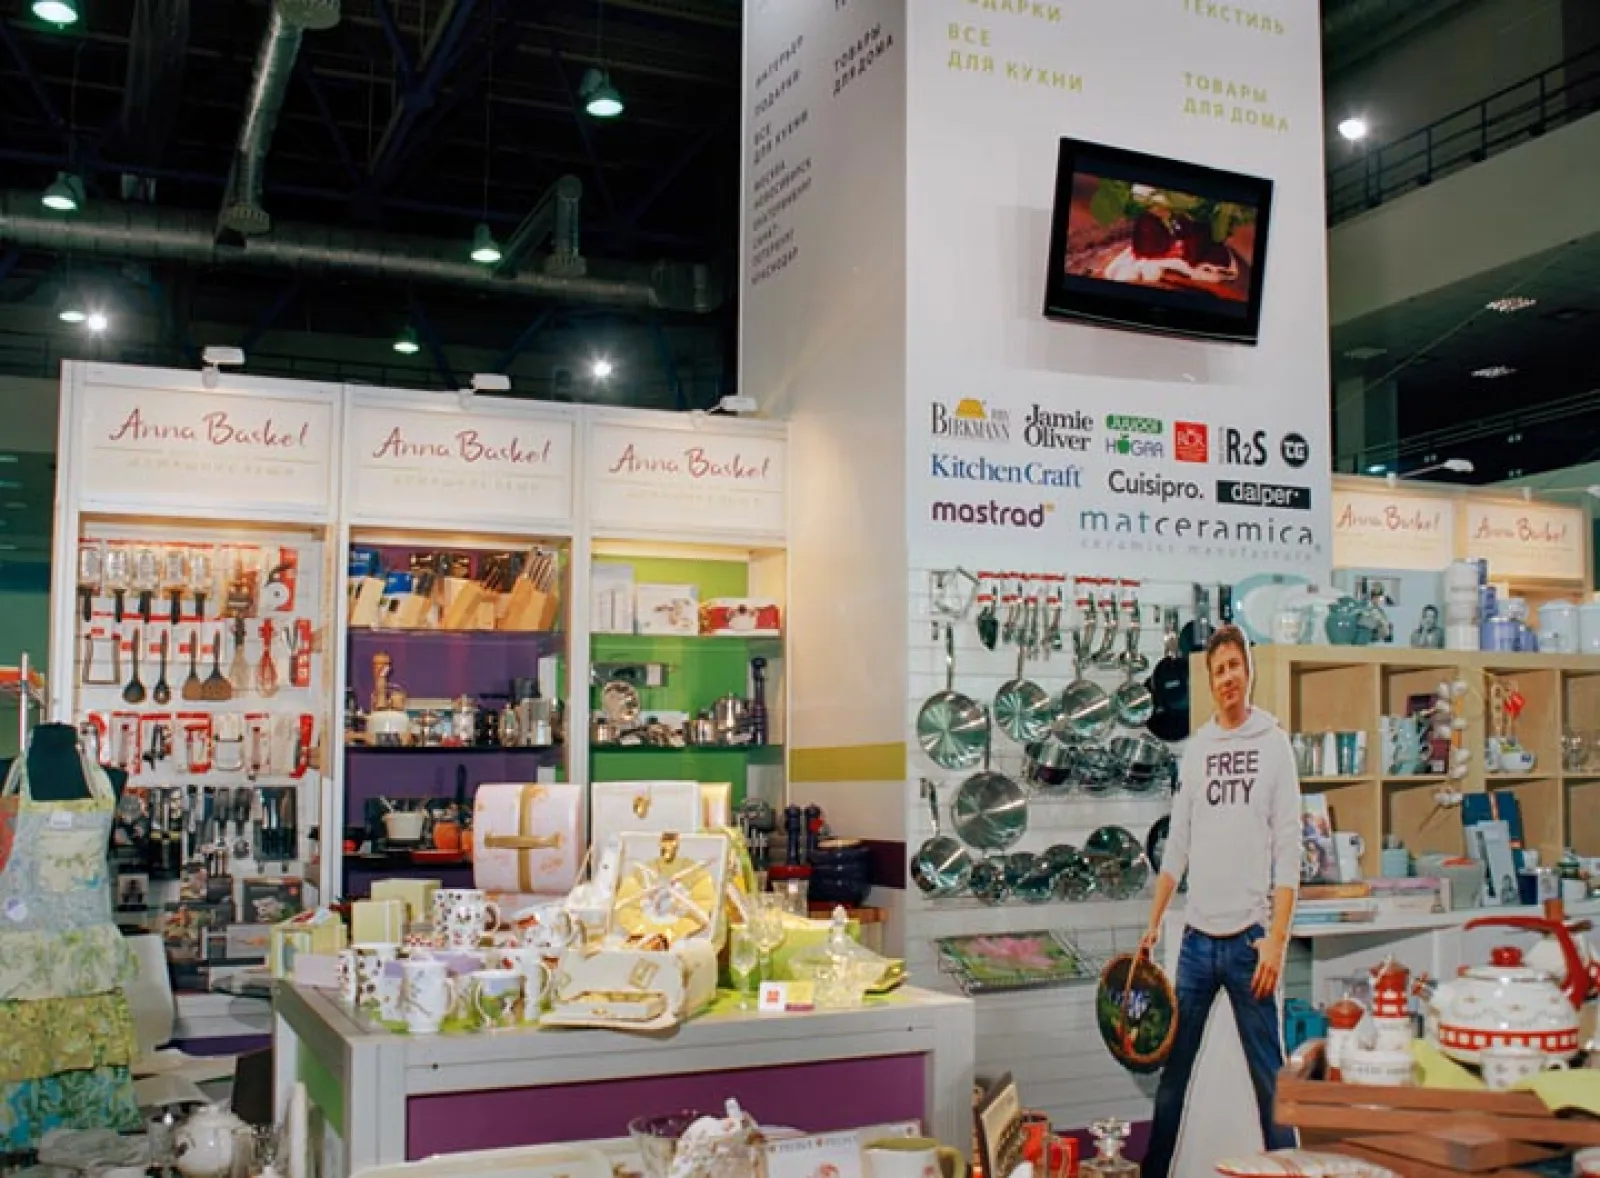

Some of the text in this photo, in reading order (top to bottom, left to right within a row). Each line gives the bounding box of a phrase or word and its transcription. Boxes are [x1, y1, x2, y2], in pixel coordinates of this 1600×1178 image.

[948, 22, 991, 47] ВСЕ
[947, 50, 1083, 92] ДЛЯ КУХНИ
[1182, 71, 1268, 103] ТОВАРЫ
[1182, 97, 1289, 133] ДЛЯ ДОМА
[109, 407, 194, 441] Anna
[1024, 404, 1095, 432] Jamie
[373, 427, 450, 458] Anna
[1023, 420, 1092, 451] Oliver
[1226, 428, 1267, 467] R2S
[609, 444, 678, 474] Anna
[932, 500, 1045, 528] mastrad
[1080, 510, 1313, 545] matceramica
[1206, 749, 1259, 777] FREE
[1206, 778, 1256, 806] CITY
